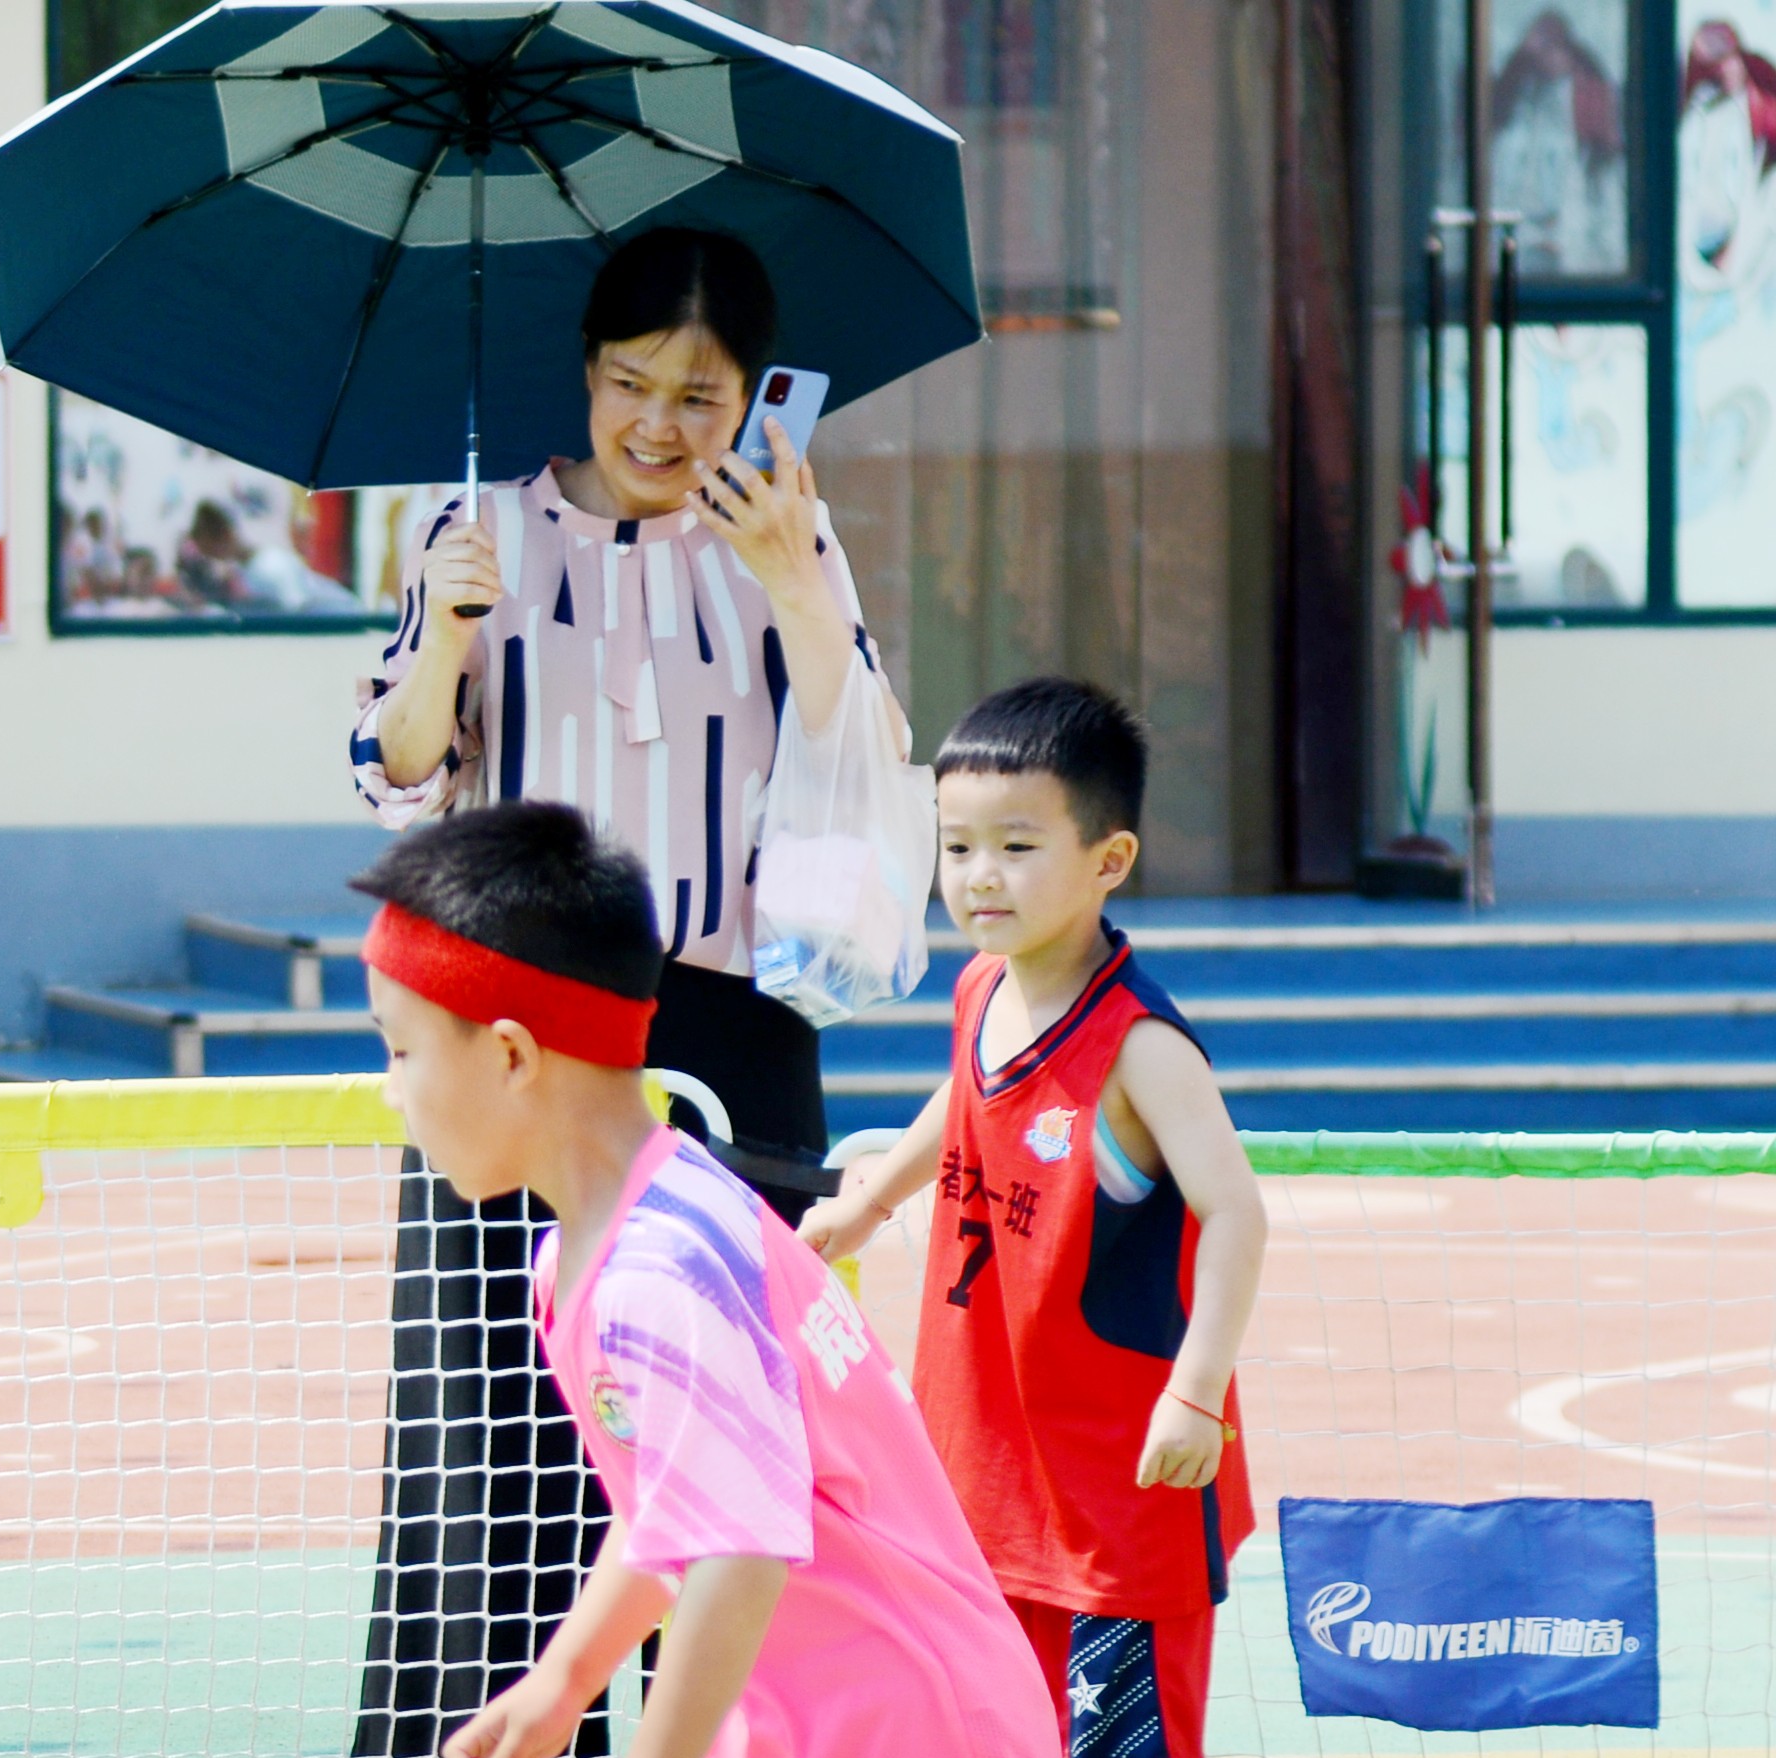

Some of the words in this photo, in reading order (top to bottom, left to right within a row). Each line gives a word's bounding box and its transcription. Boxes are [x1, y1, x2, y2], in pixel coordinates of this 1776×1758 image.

[946, 1217, 995, 1309] 7
[1349, 1617, 1512, 1662] PODIYEEN
[1512, 1616, 1625, 1657] 派迪茵
